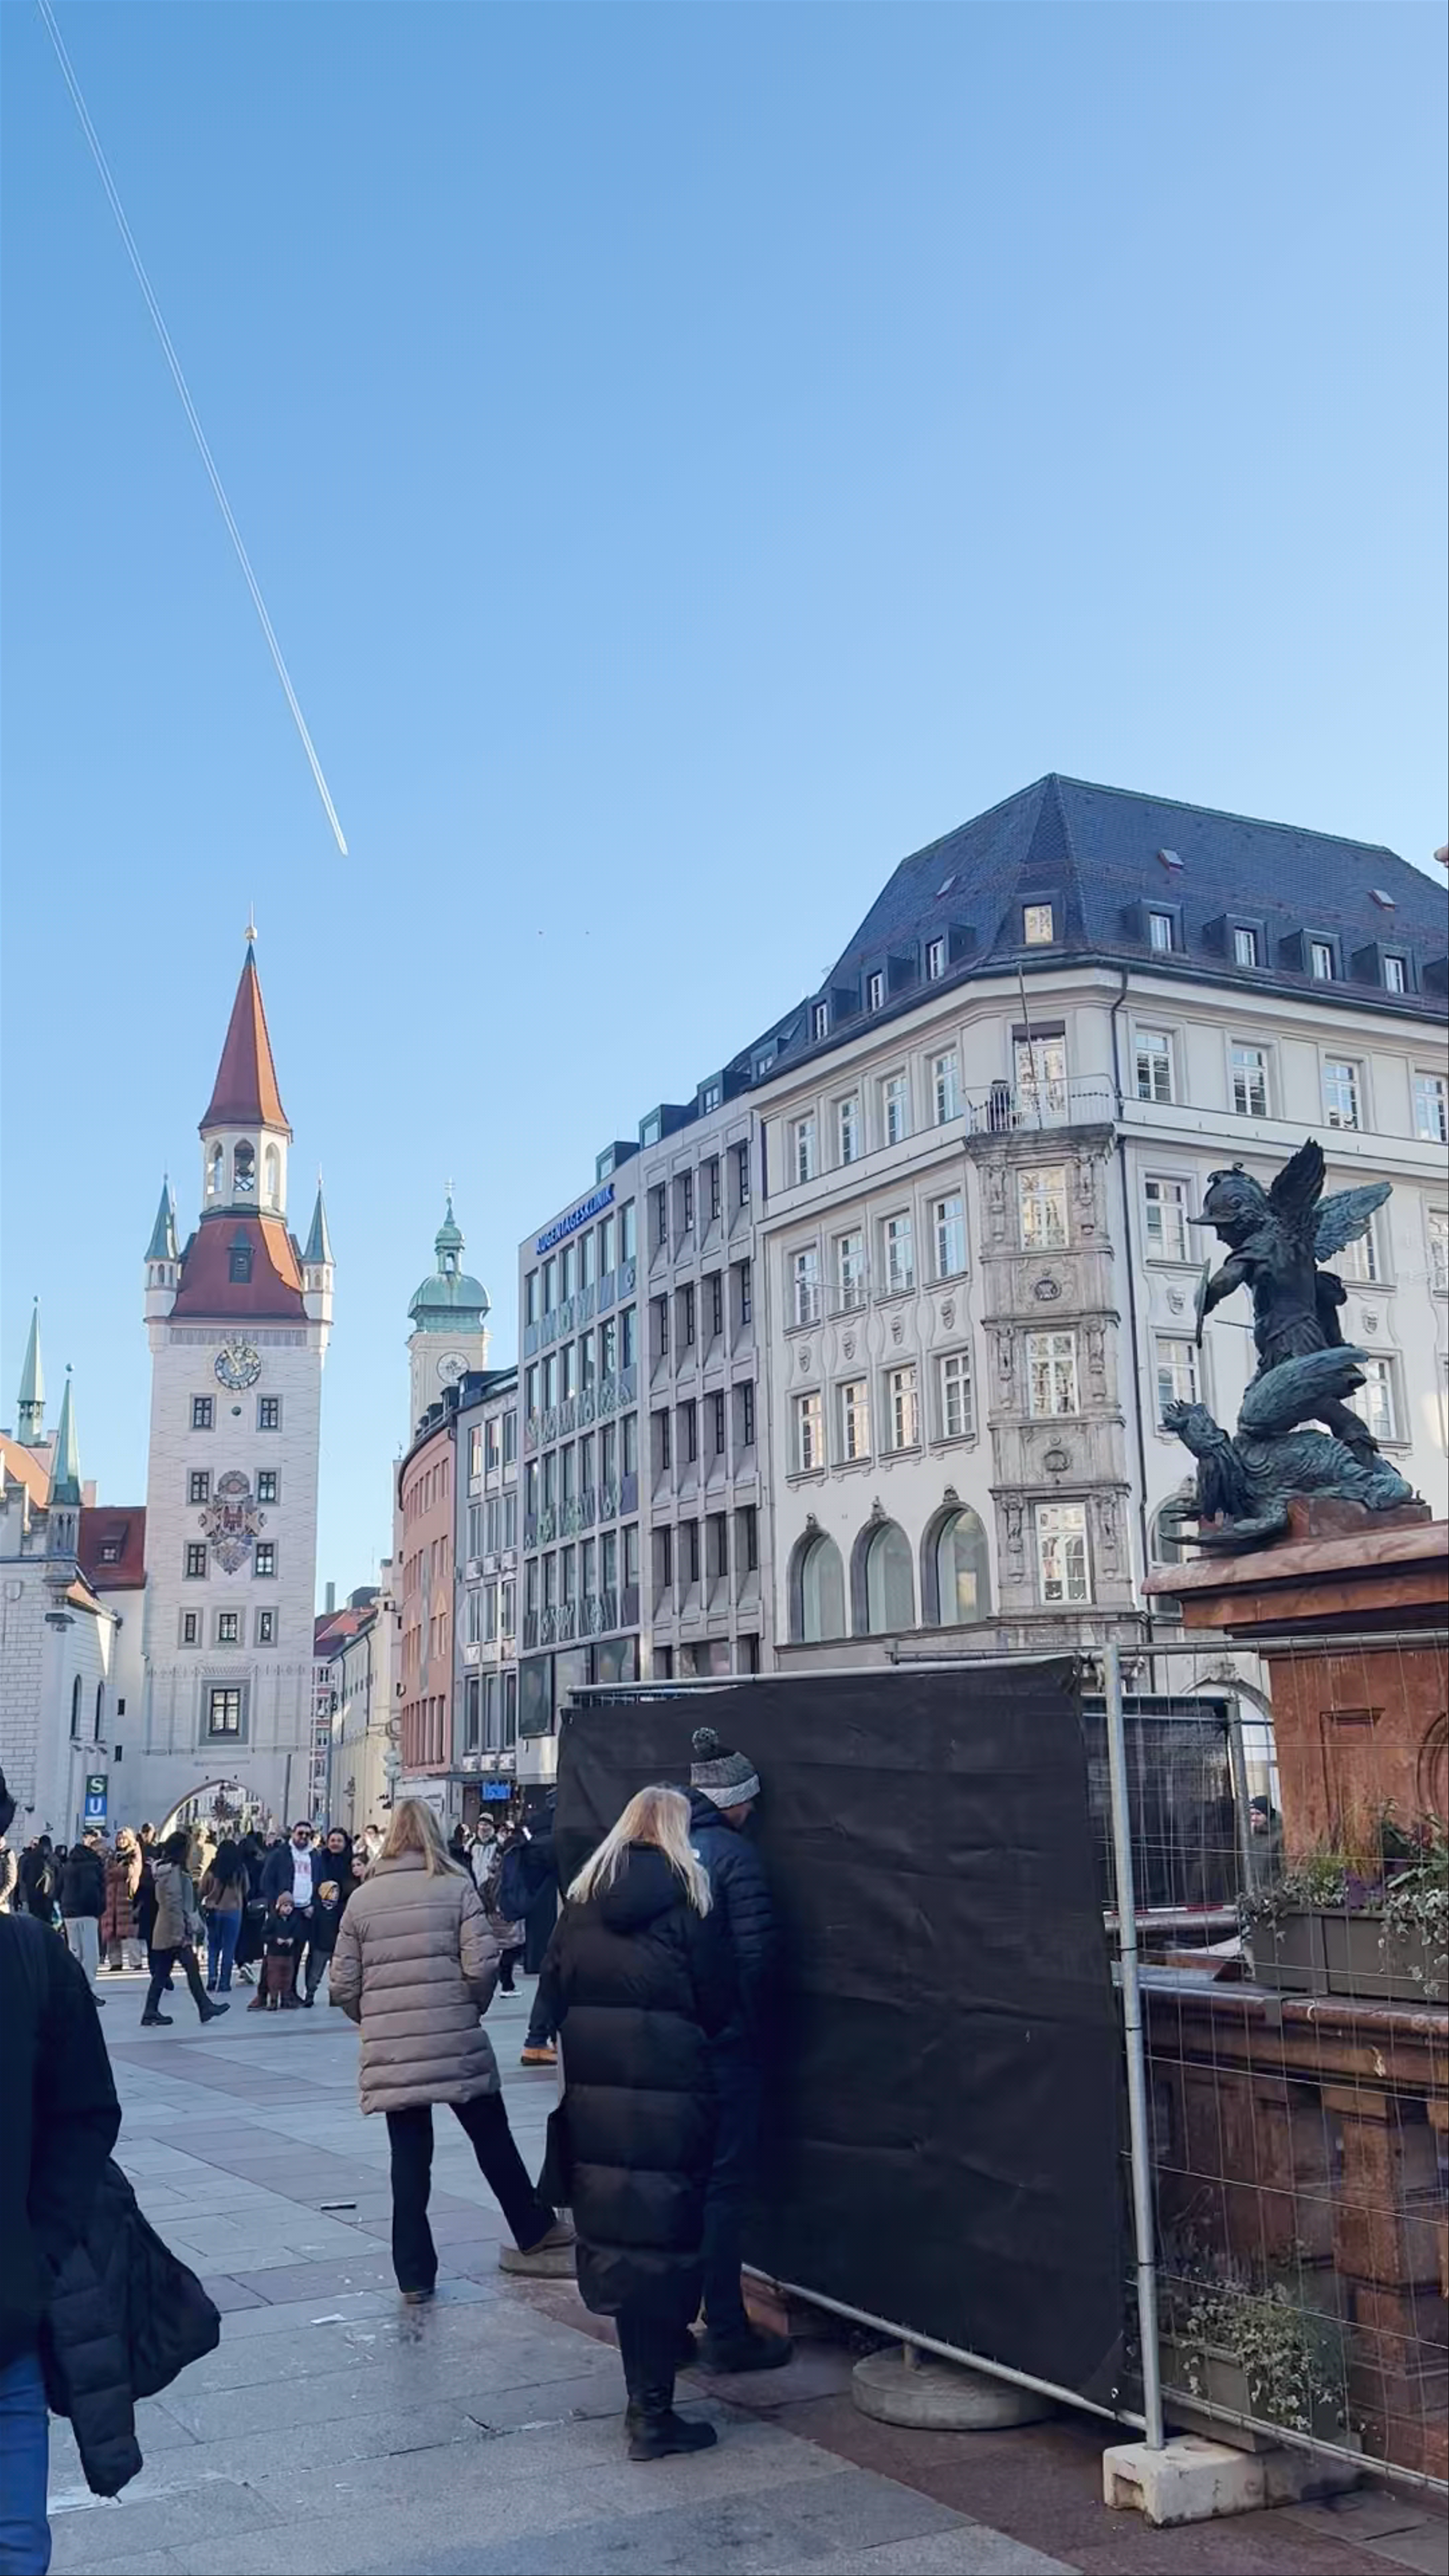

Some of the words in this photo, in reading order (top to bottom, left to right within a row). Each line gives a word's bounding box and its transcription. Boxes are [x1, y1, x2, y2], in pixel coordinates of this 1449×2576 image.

[536, 1183, 615, 1255] AUGENTAGESKLINIK
[91, 1778, 103, 1793] S
[90, 1797, 102, 1813] U
